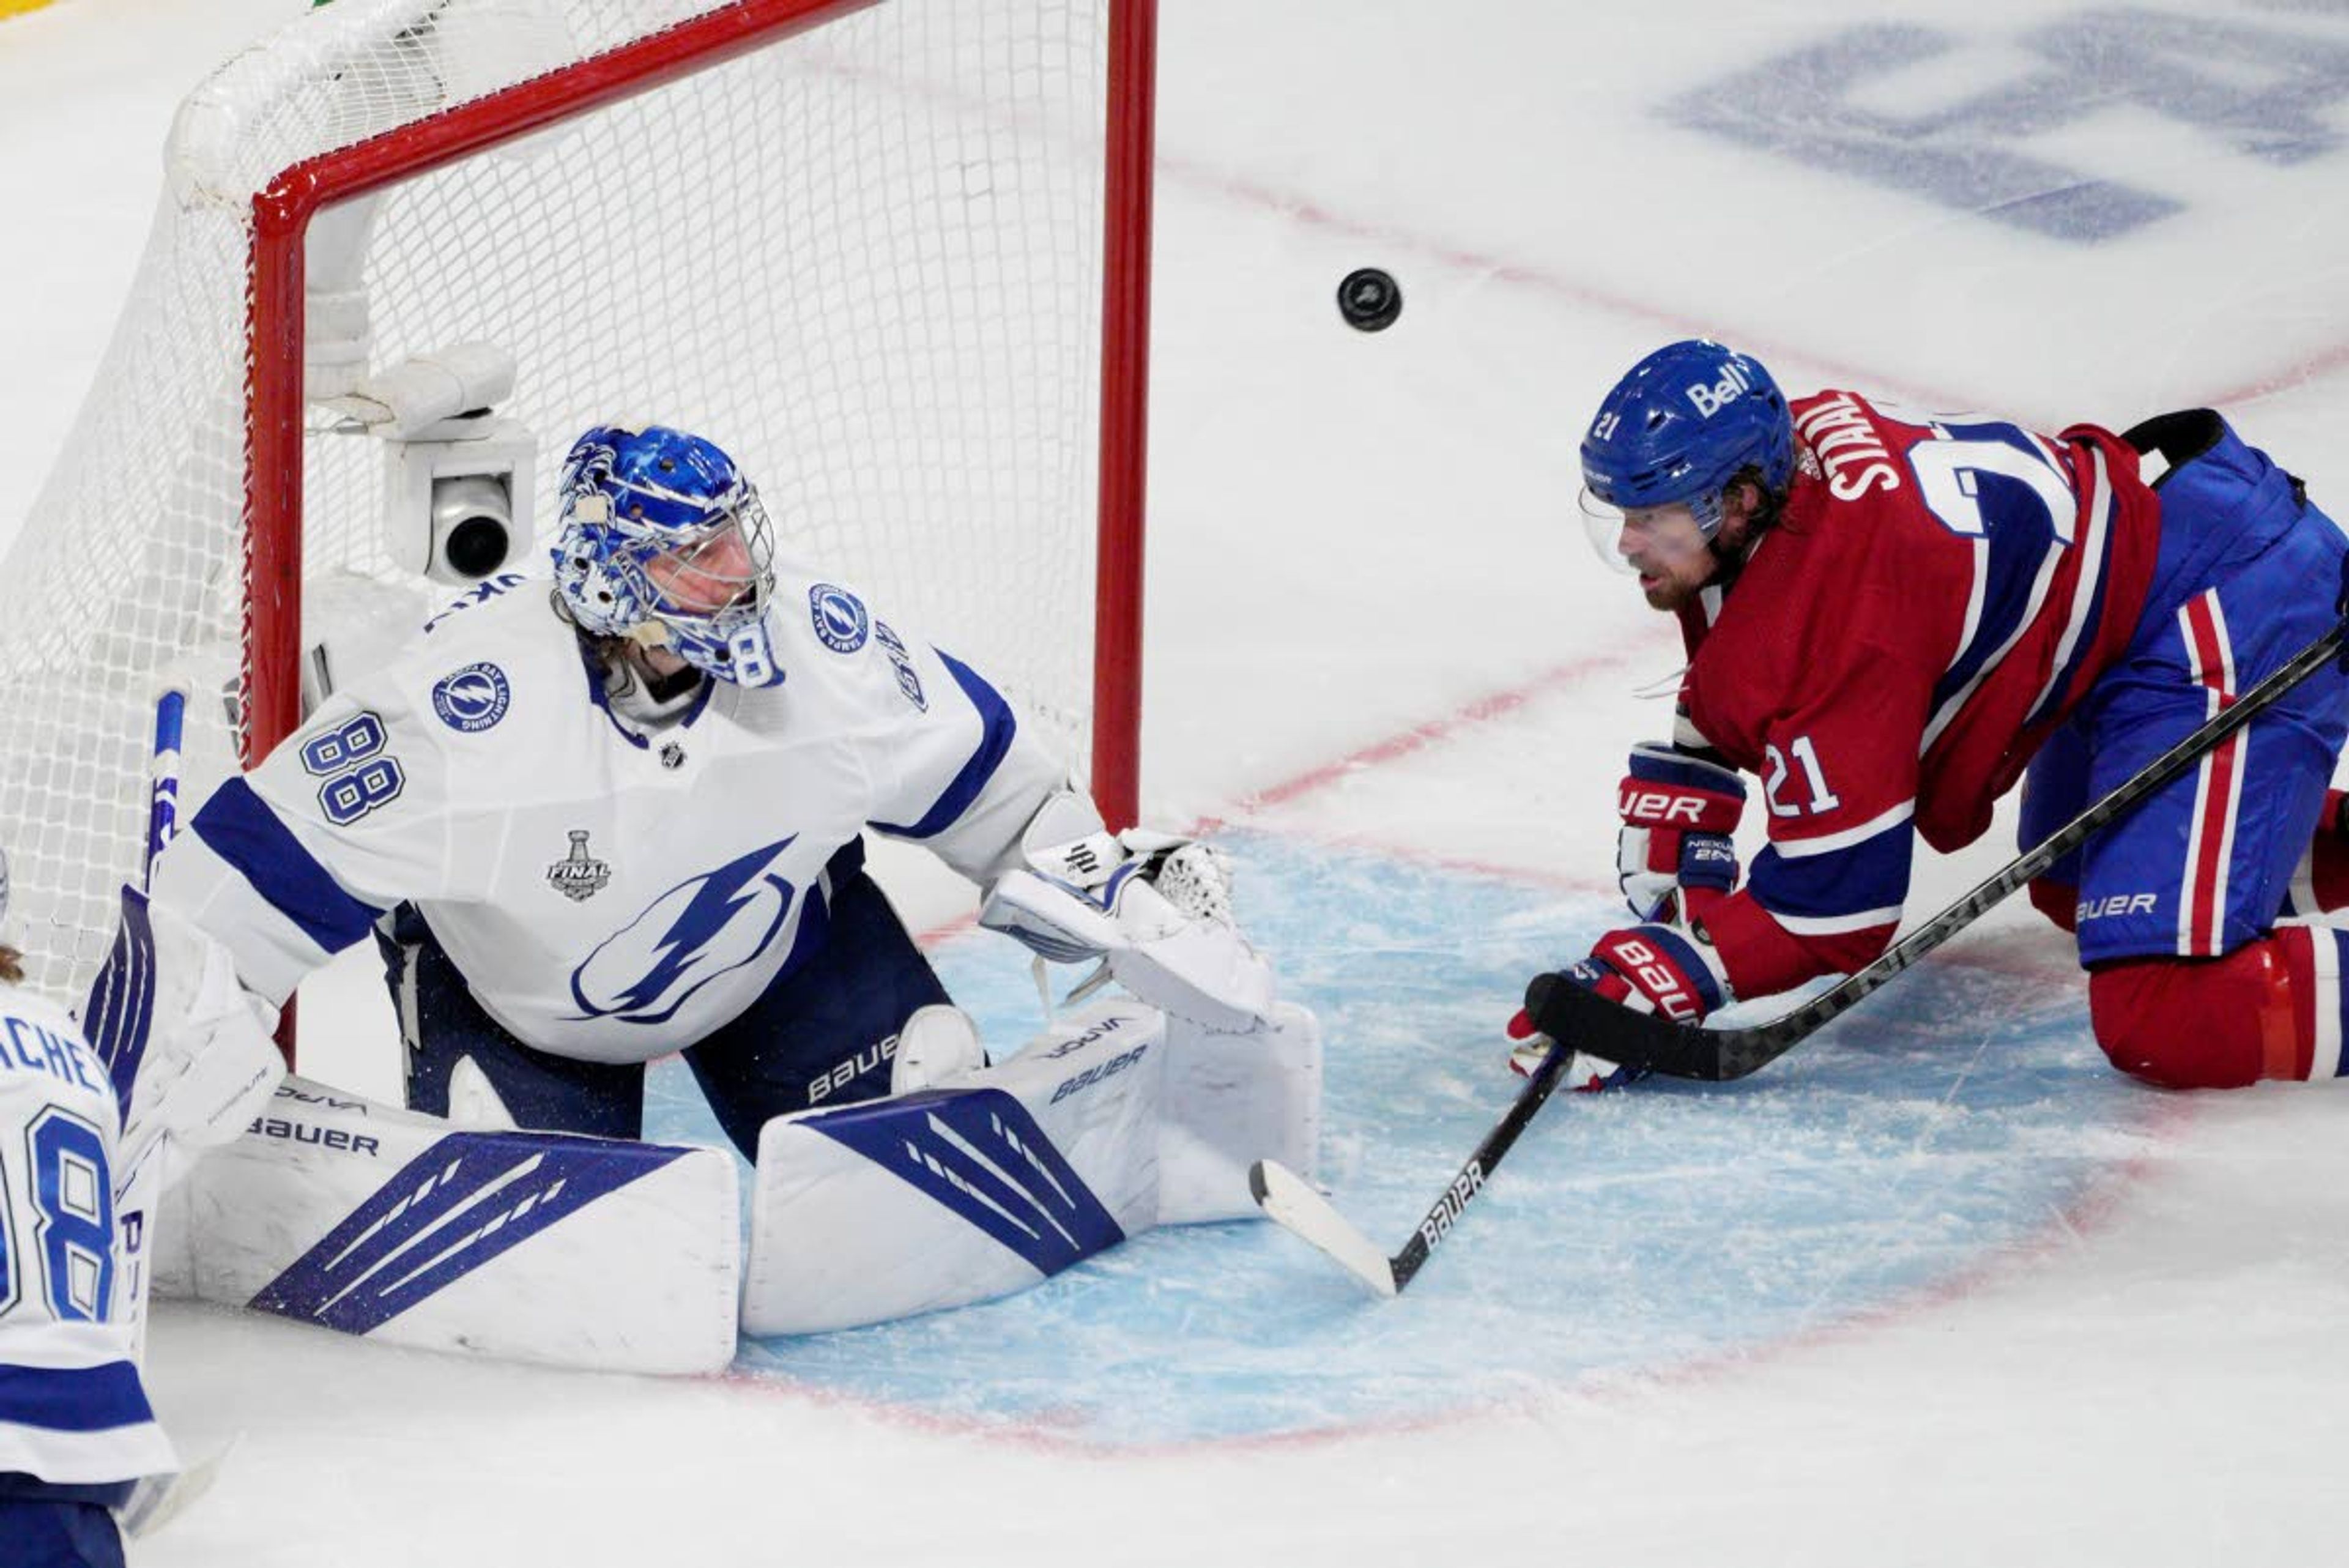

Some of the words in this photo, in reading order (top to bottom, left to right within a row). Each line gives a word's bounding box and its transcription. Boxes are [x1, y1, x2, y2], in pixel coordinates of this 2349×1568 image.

[1593, 412, 1620, 441] 21
[1687, 363, 1749, 418] Bell
[1797, 393, 1899, 501] STAAL
[300, 710, 406, 827] 88
[1765, 736, 1840, 816] 21
[548, 864, 610, 879] FINAL
[1050, 1044, 1148, 1105] BAUER
[0, 1103, 115, 1324] 8
[1420, 1160, 1486, 1253] BAUER
